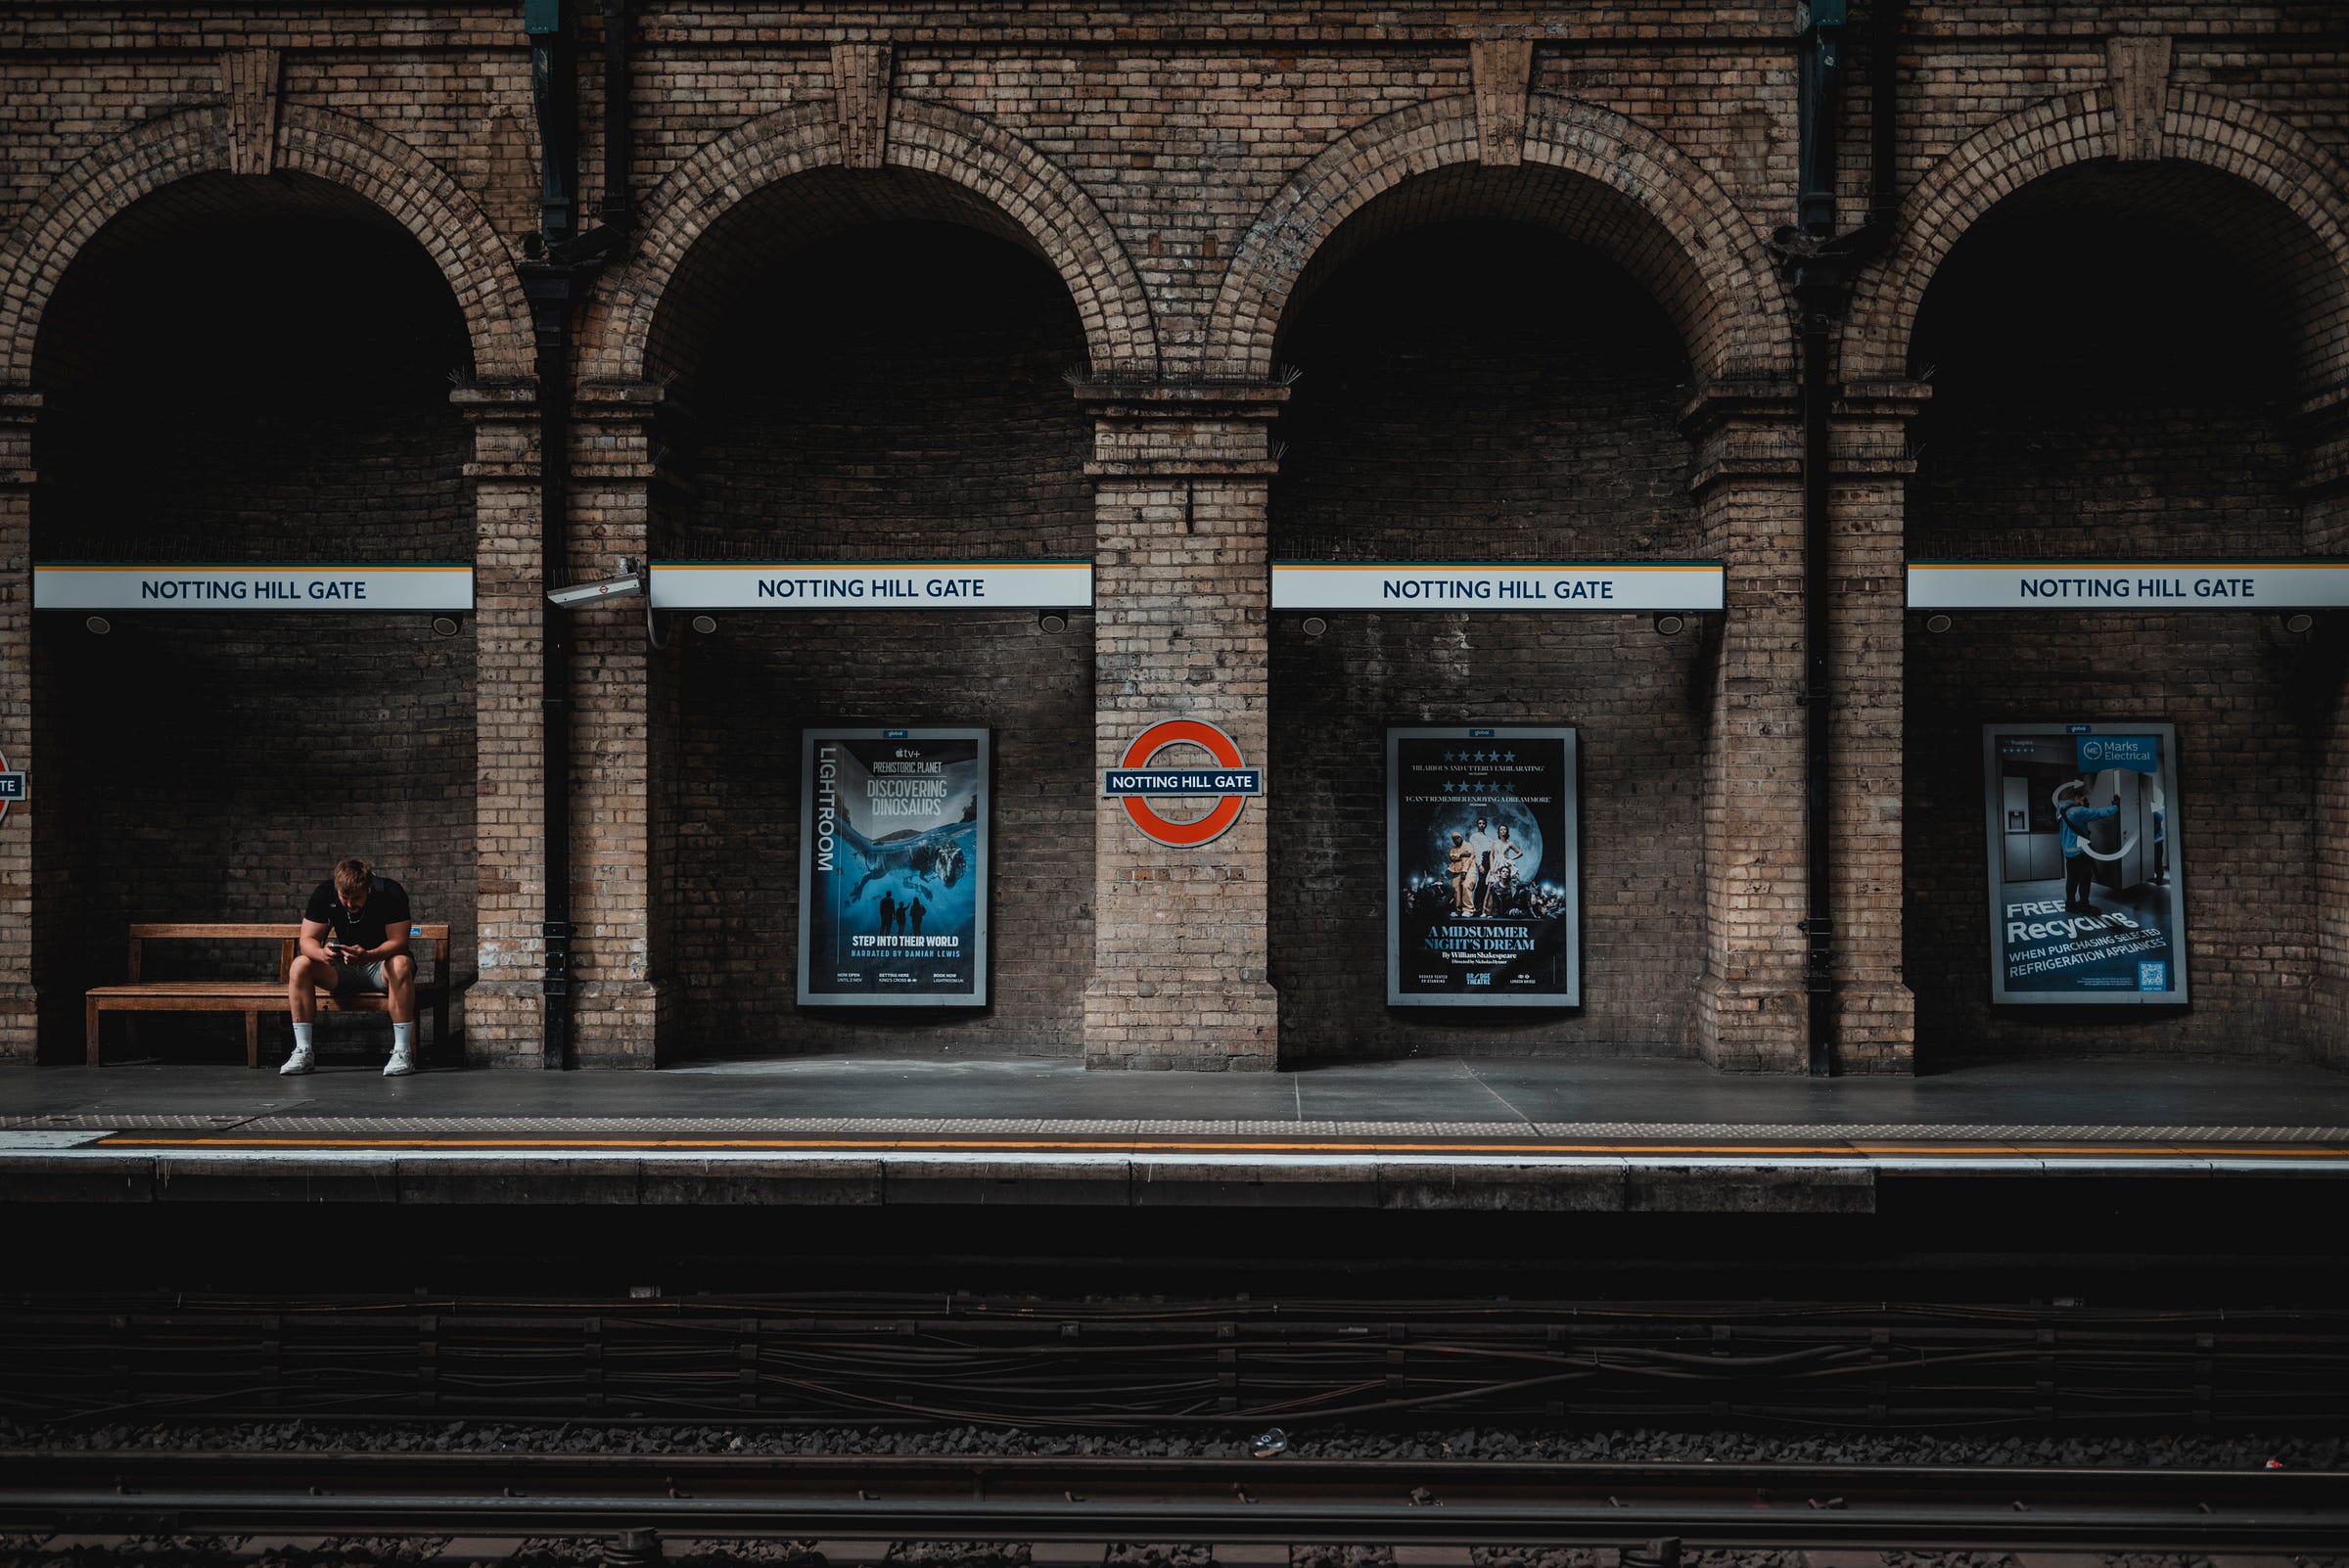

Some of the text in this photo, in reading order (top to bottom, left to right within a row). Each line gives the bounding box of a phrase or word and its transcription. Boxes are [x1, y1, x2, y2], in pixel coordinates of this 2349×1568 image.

[142, 580, 367, 599] NOTTING HILL GATE
[758, 579, 985, 597] NOTTING HILL GATE
[1383, 579, 1614, 599] NOTTING HILL GATE
[2020, 578, 2255, 598] NOTTING HILL GATE
[903, 749, 921, 759] tv+
[2104, 741, 2139, 752] Marks
[2104, 752, 2150, 761] Electrical
[873, 761, 943, 773] PREHISTORIC PLANET
[866, 779, 947, 798] DISCOVERING
[1113, 775, 1252, 789] NOTTING HILL GATE
[817, 748, 837, 871] LIGHTROOM
[872, 799, 942, 816] DINOSAURS
[2006, 899, 2066, 918] FREE
[1429, 926, 1529, 938] A MIDSUMMER
[2006, 912, 2140, 944] Recycling
[852, 936, 959, 947] STEP INTO THEIR WORLD
[1424, 939, 1536, 950] NIGHT'S DREAM
[2008, 928, 2161, 963] WHEN PURCHASING SELECTED
[1476, 951, 1517, 960] Shakespeare
[2009, 949, 2105, 979] REFRIGERATION
